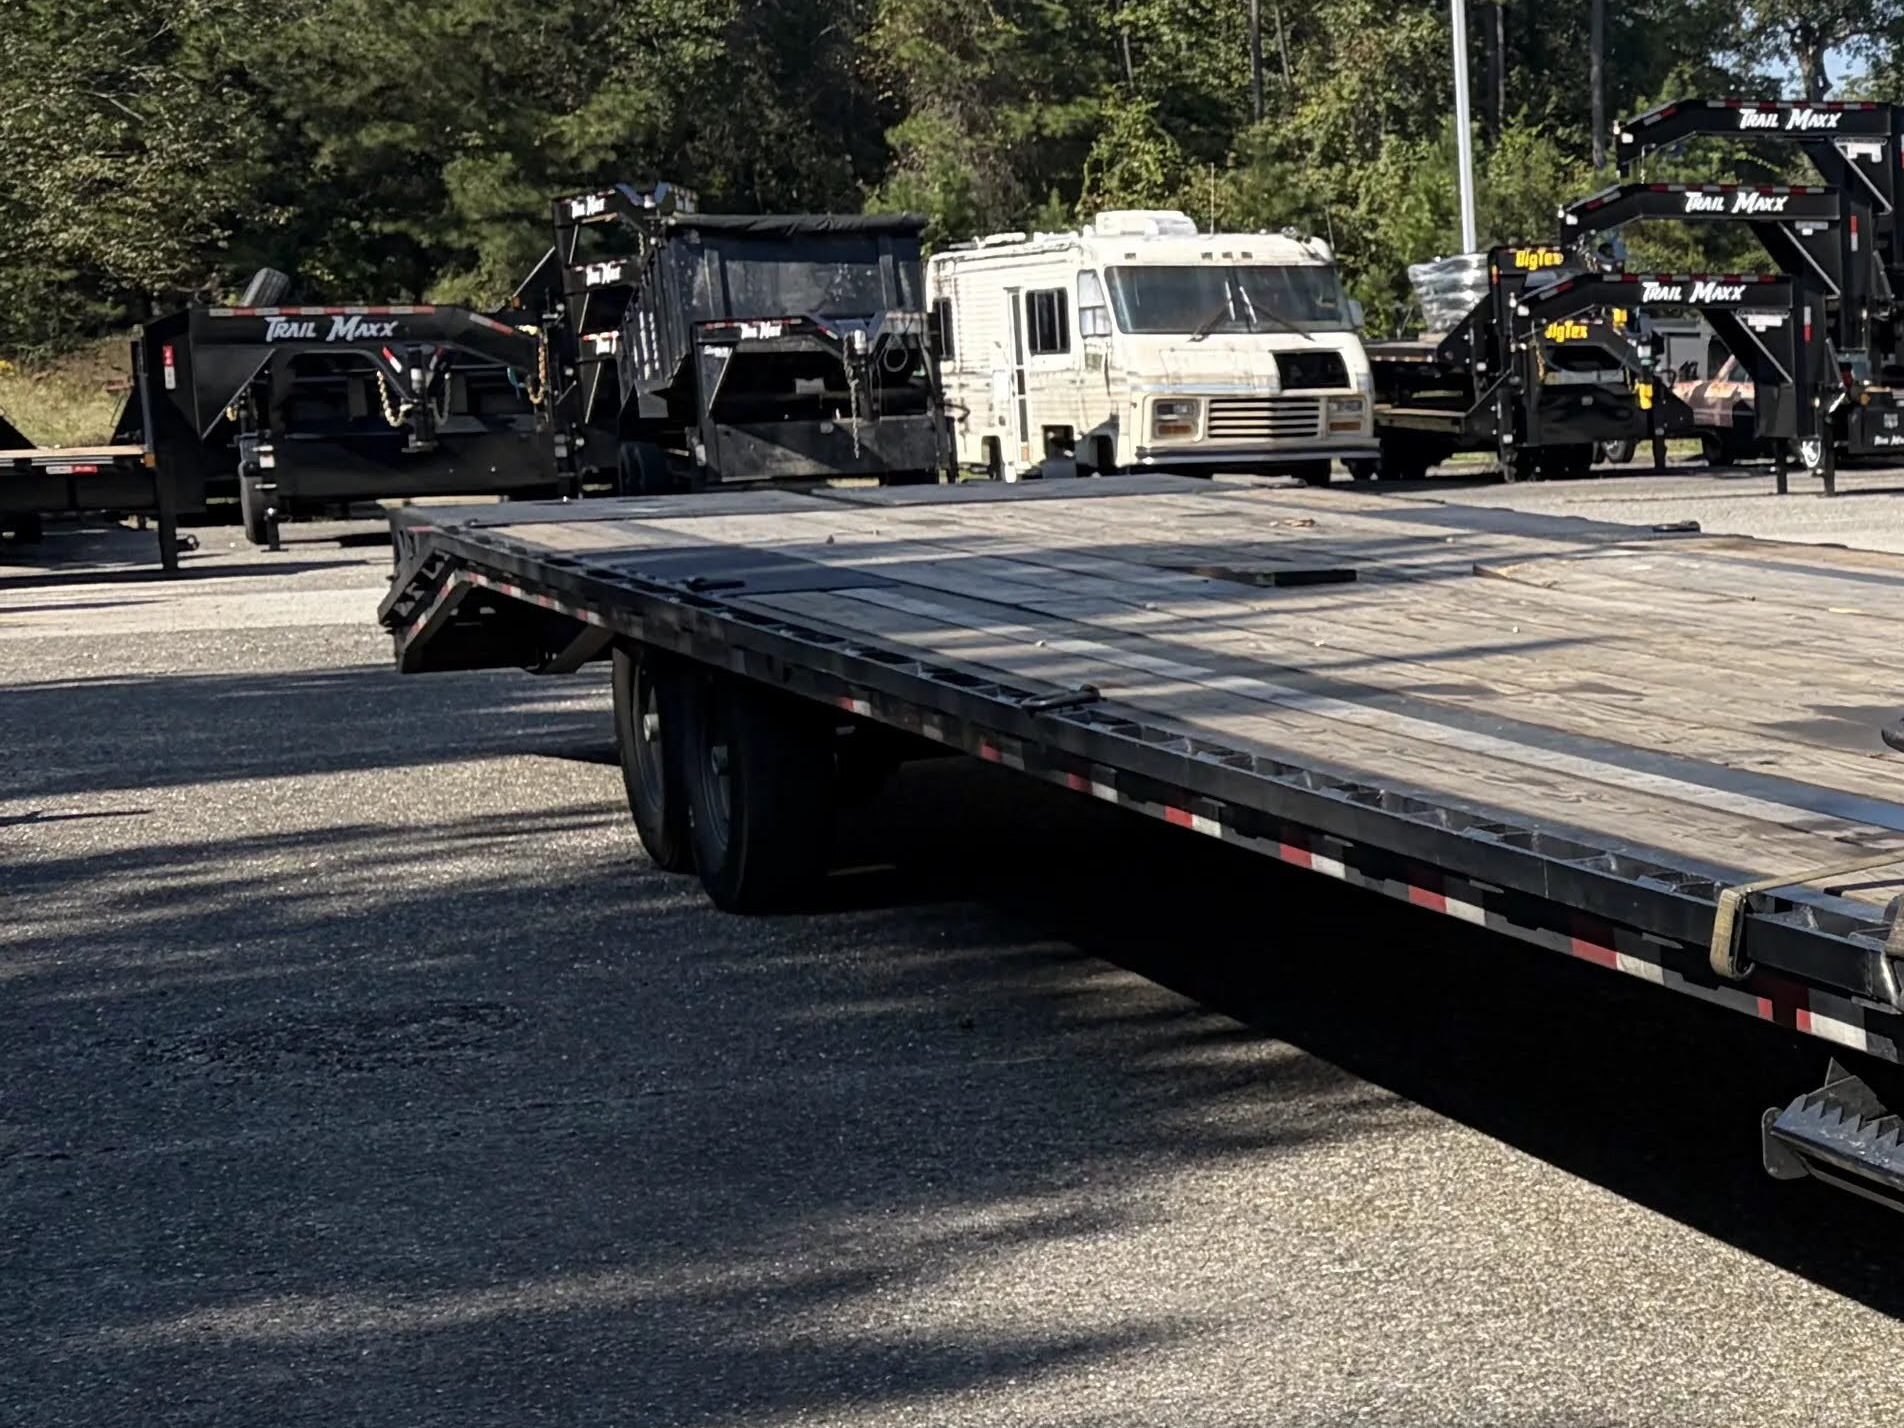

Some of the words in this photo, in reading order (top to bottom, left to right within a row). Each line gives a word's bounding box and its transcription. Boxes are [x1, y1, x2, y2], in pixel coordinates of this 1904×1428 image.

[1738, 107, 1779, 129] TRAIL
[1785, 107, 1842, 130] MAXX
[1684, 191, 1725, 213] TRAIL
[1731, 191, 1789, 214] MAXX
[1641, 281, 1682, 303] TRAIL
[1688, 281, 1747, 303] MAXX
[263, 316, 317, 342] TRAIL
[325, 315, 399, 342] MAXX
